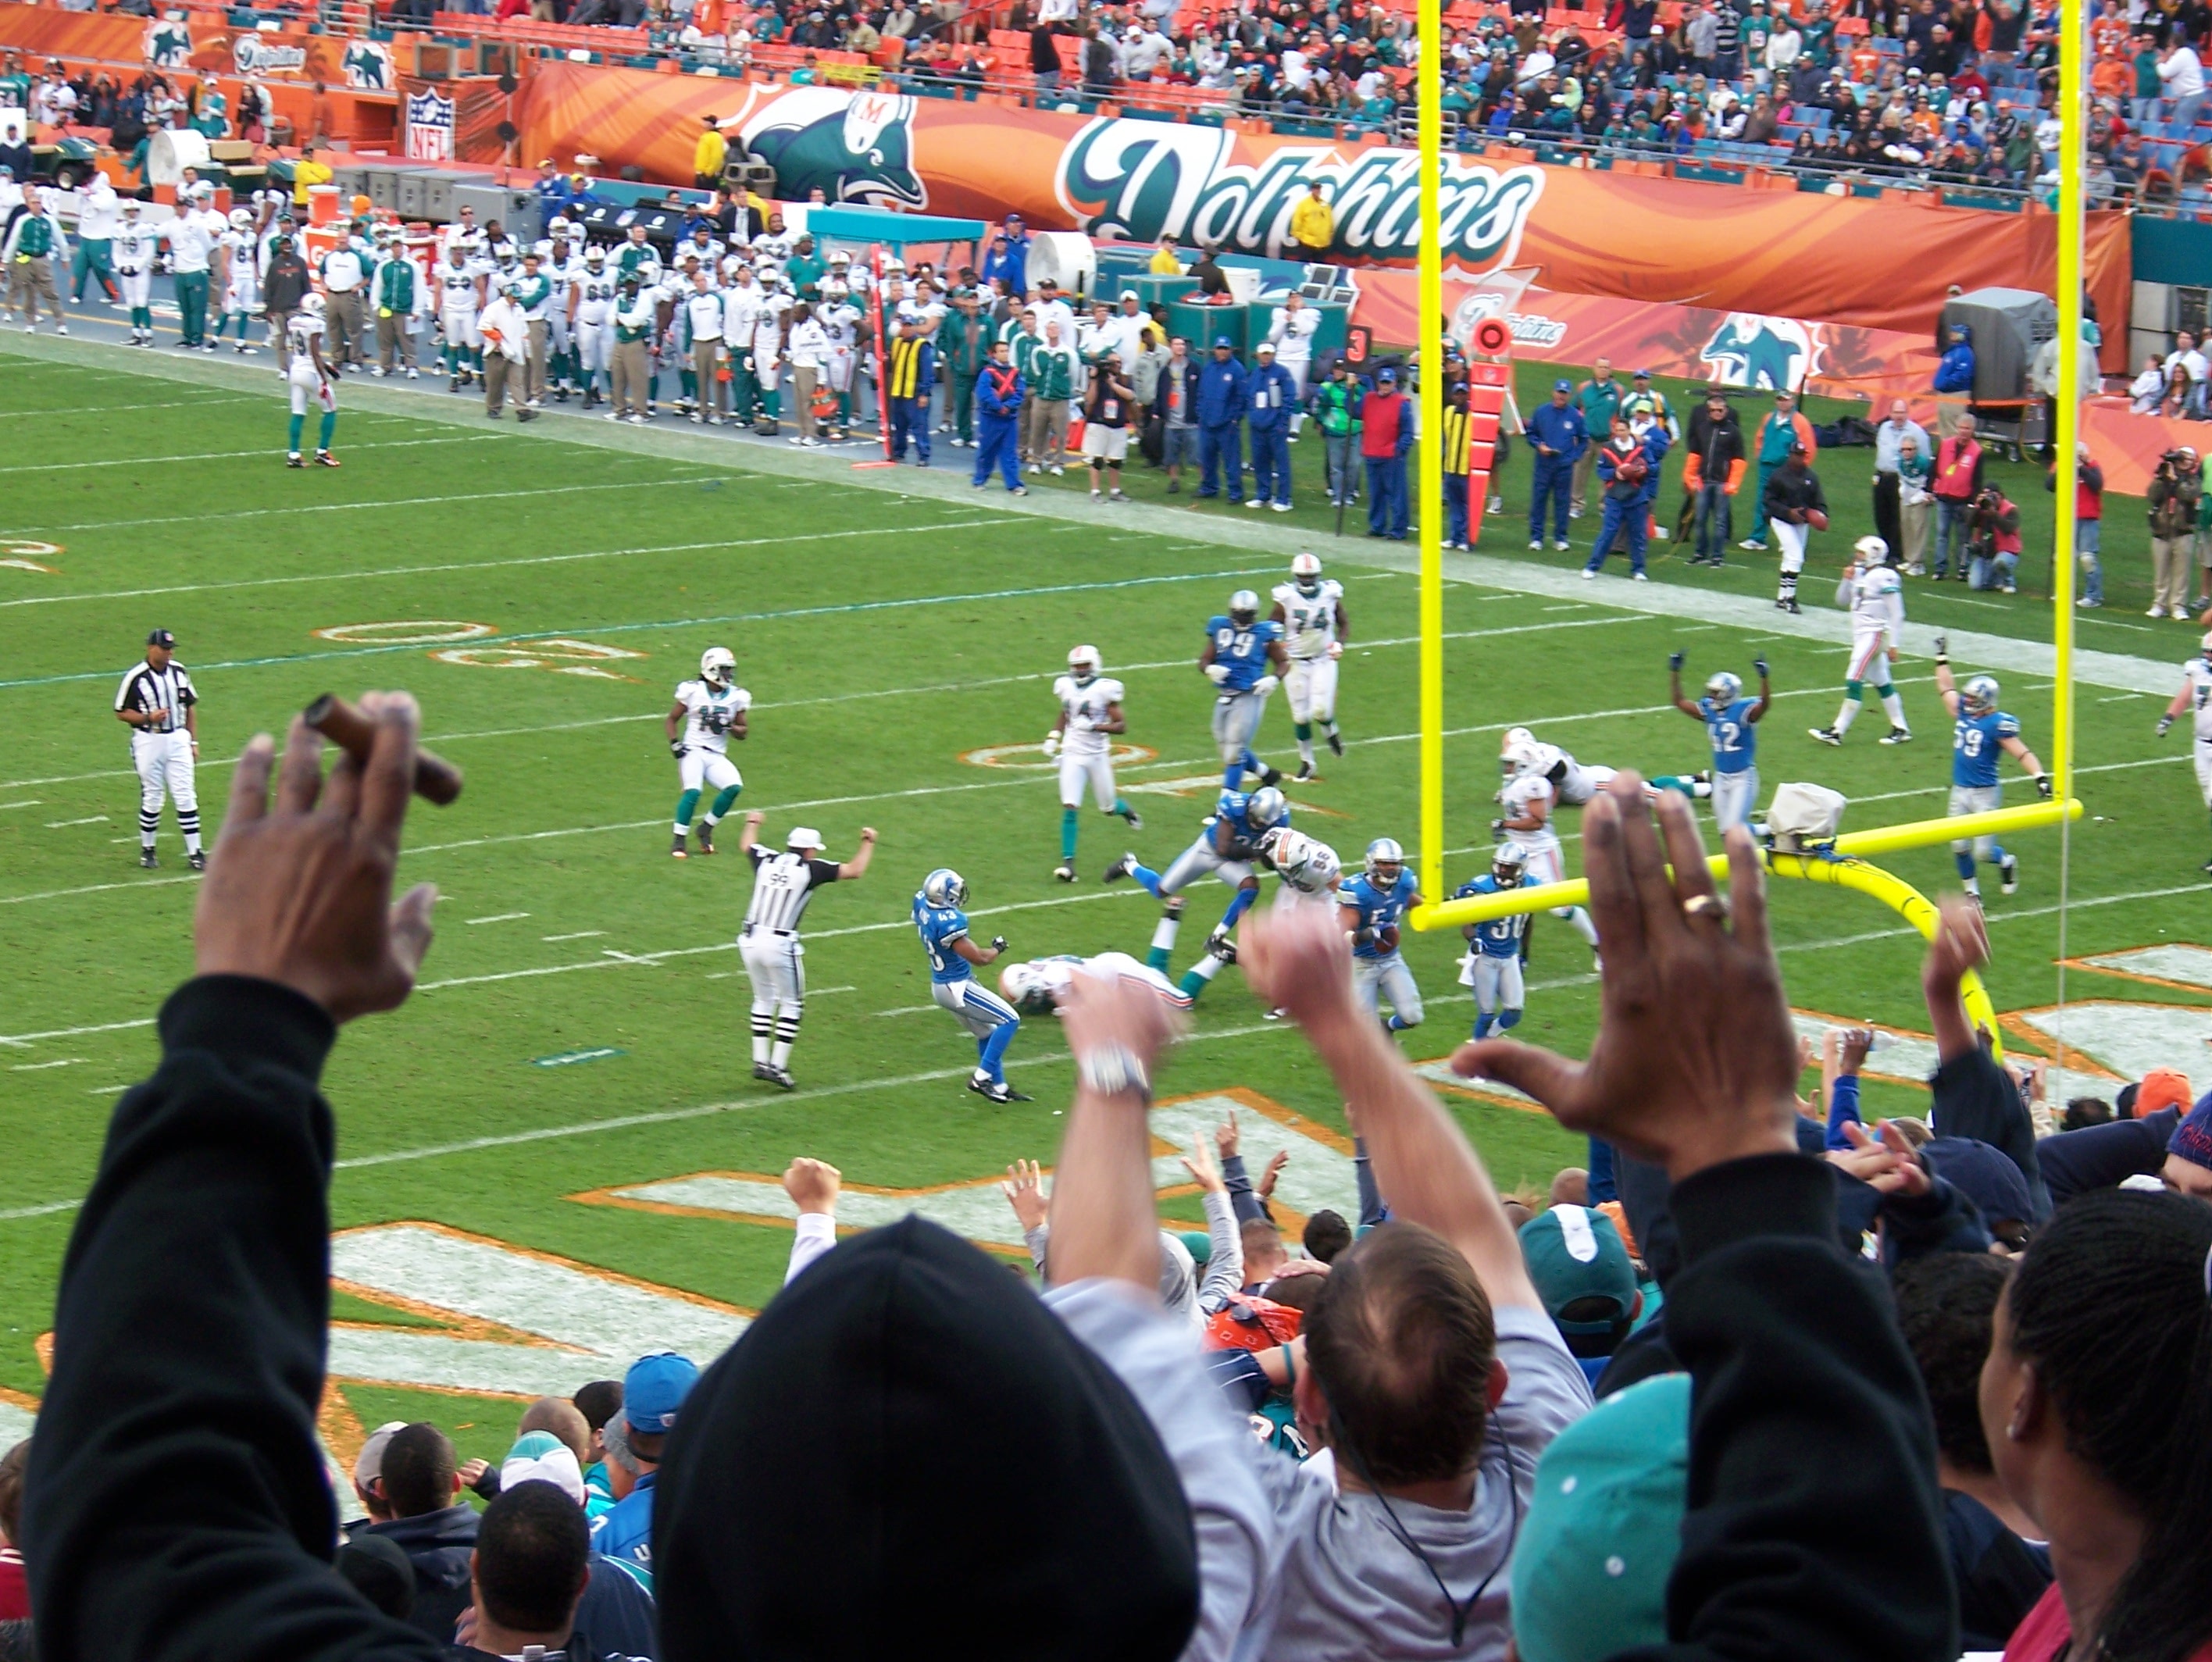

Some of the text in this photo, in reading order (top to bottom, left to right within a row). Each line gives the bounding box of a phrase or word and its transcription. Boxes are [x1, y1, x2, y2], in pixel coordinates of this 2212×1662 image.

[858, 95, 889, 124] M
[410, 126, 448, 161] NFL
[1058, 116, 1545, 269] Dolphins
[1454, 293, 1568, 348] Dhins
[1345, 330, 1367, 363] 3
[1293, 607, 1329, 634] 74
[937, 910, 958, 922] 43
